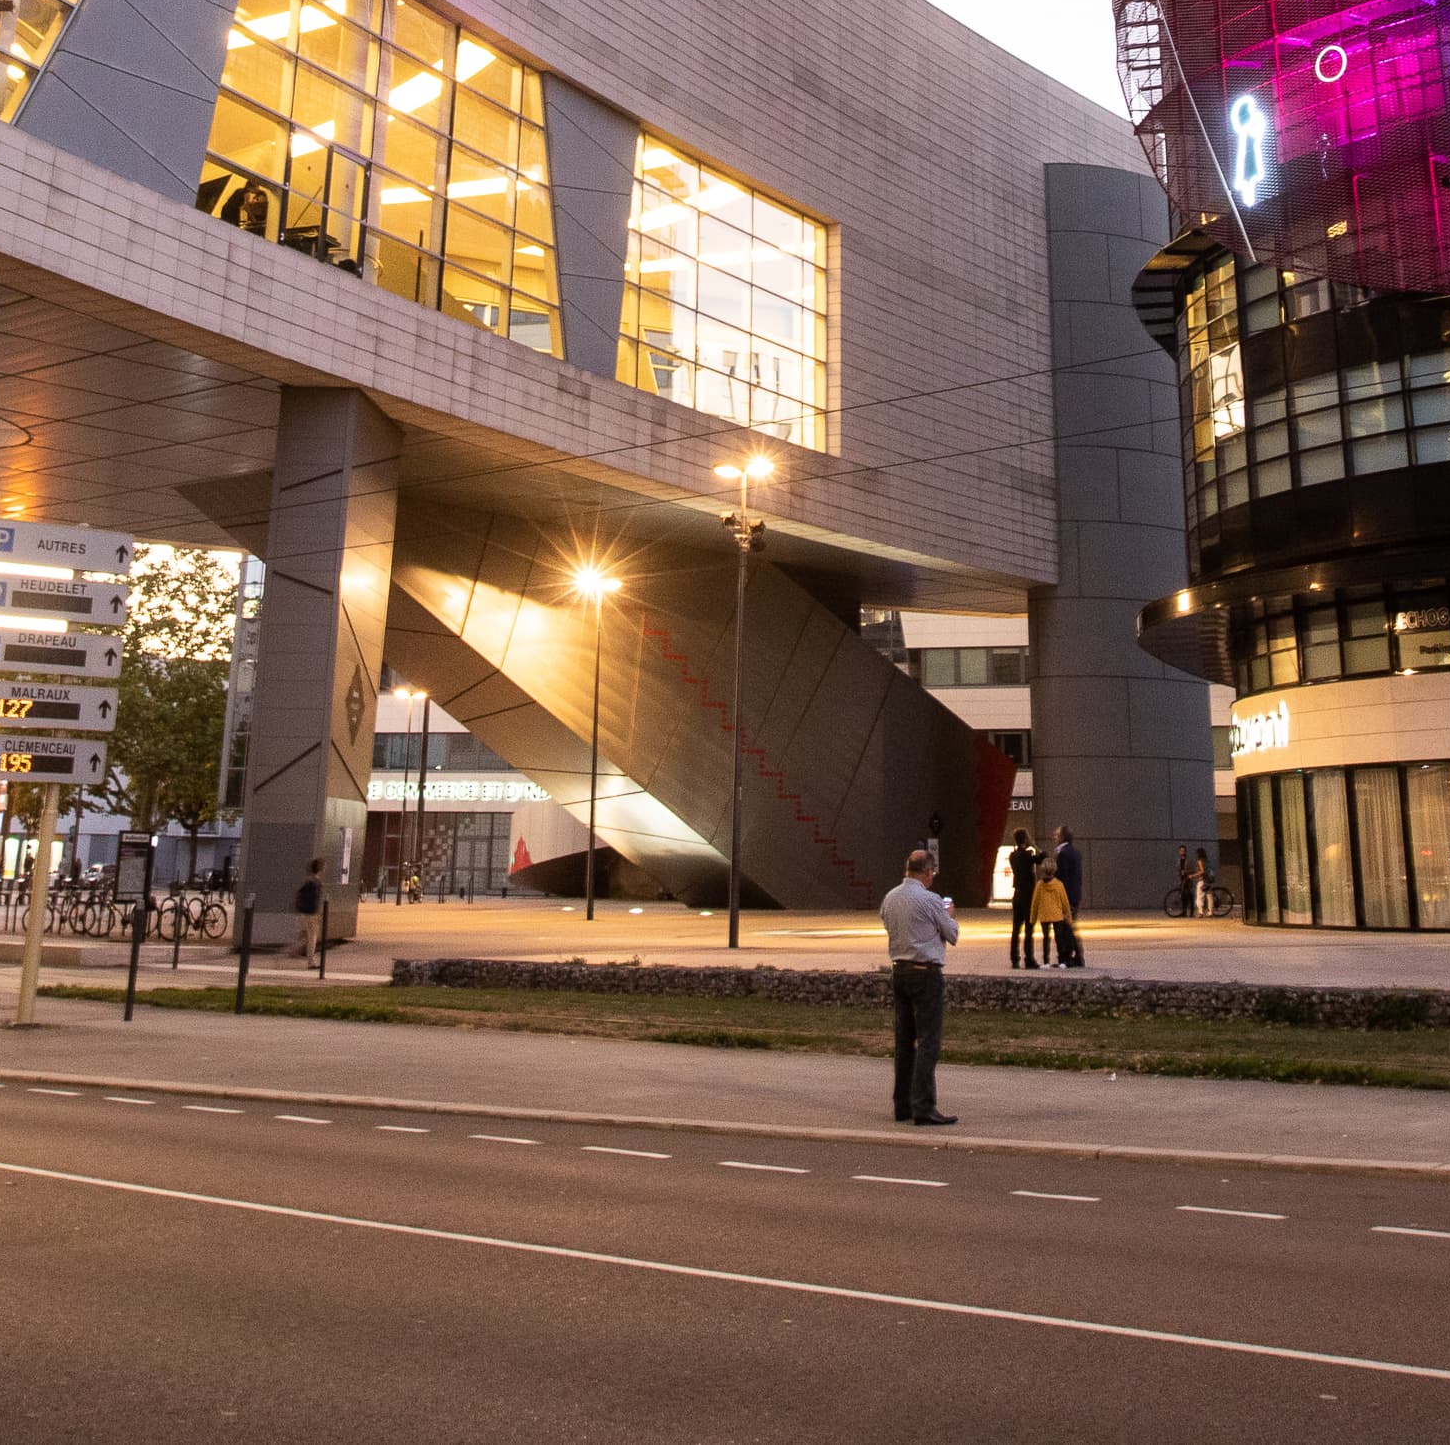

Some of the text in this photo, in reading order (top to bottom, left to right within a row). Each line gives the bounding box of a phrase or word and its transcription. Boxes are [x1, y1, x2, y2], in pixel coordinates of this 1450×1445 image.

[37, 540, 86, 554] AUTRES
[20, 579, 87, 595] HEUDELET
[18, 633, 77, 648] DRAPEAU
[10, 687, 71, 702] MALRAUX
[4, 740, 76, 755] CLEMENCEAU
[482, 782, 503, 801] ET
